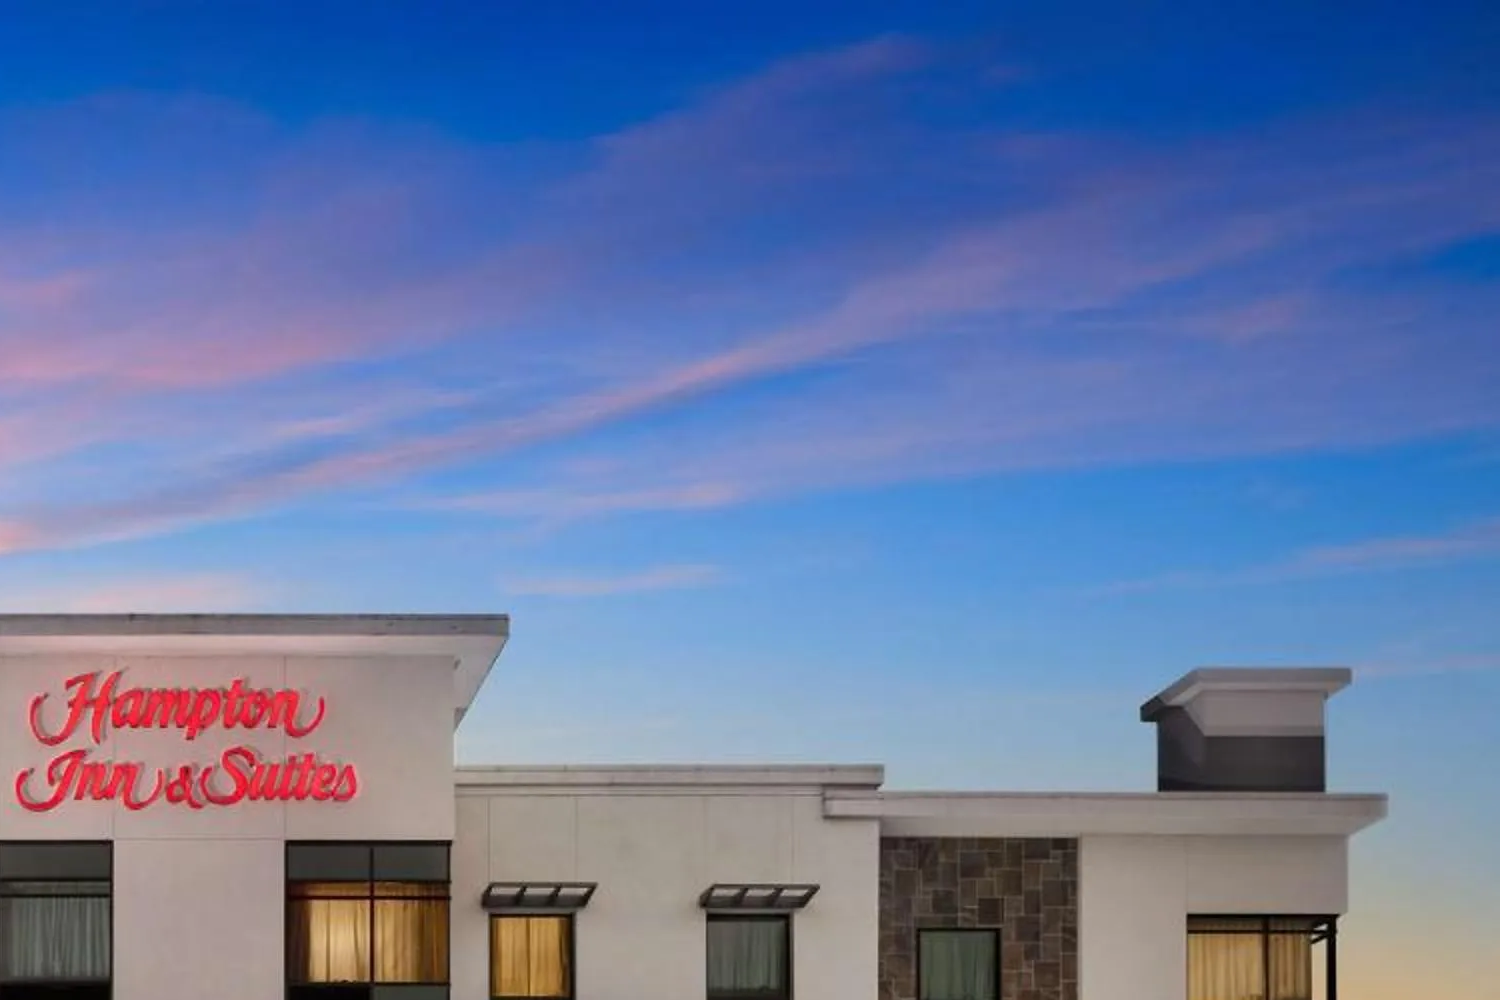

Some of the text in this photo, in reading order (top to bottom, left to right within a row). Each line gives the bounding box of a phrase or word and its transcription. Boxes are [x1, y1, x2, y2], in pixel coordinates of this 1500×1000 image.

[30, 671, 325, 746] Hampton
[15, 746, 357, 812] Inn & Suites
